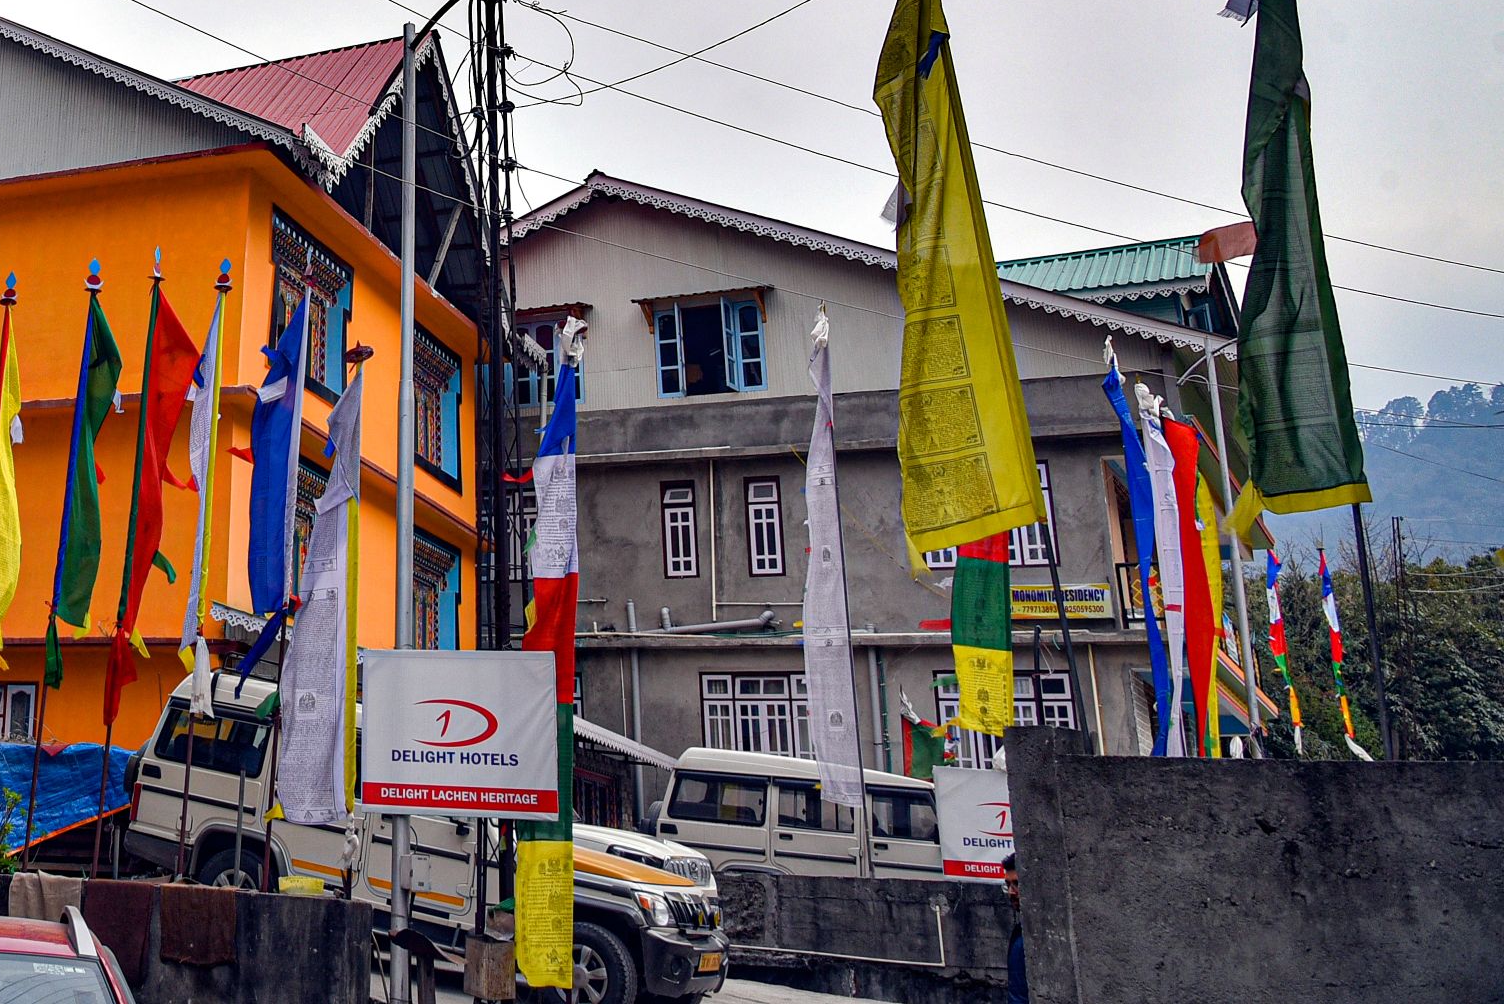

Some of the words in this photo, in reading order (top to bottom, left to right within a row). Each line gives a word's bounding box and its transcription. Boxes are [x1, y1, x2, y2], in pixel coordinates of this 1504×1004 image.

[1012, 589, 1058, 602] MONOMITA
[391, 749, 456, 764] DELIGHT
[460, 752, 519, 767] HOTELS
[381, 787, 429, 800] DELIGHT
[431, 789, 479, 803] LACHEN
[481, 792, 538, 805] HERITAGE
[963, 837, 1012, 849] DELIGHT
[964, 864, 1002, 874] DELIGHT
